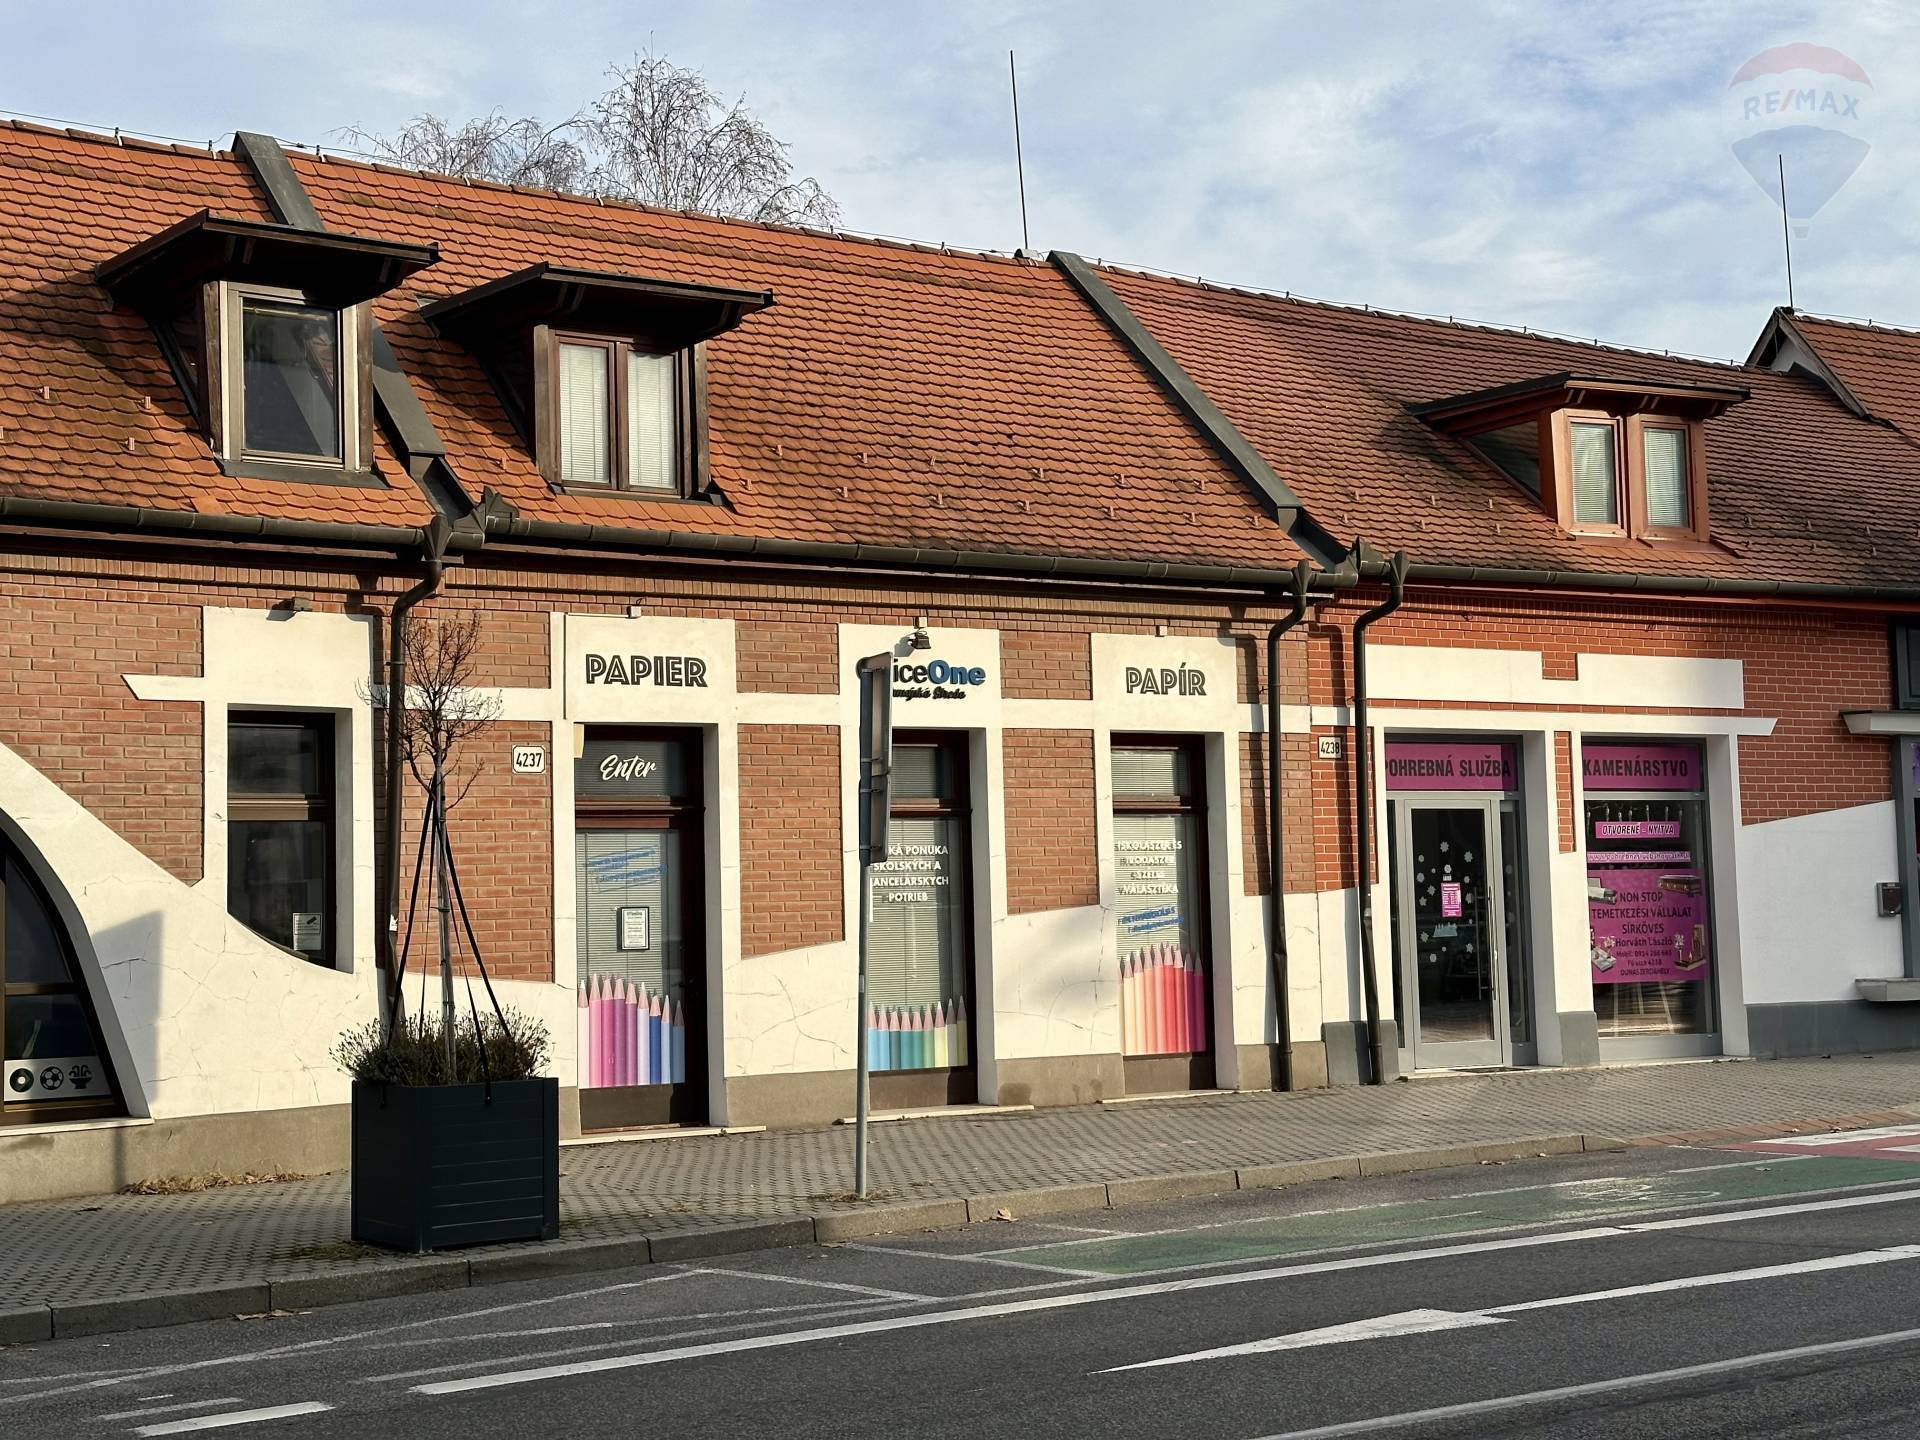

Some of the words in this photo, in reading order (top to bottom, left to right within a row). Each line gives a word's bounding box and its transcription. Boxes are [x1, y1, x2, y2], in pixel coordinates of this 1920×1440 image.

[585, 653, 708, 688] PAPIER
[892, 658, 987, 686] iceOne
[1125, 661, 1207, 696] PAPÍR
[1320, 740, 1340, 755] 4238
[515, 751, 543, 768] 4237
[600, 754, 657, 782] Enter
[1459, 754, 1511, 777] SLUŽBA
[1583, 754, 1689, 777] KAMENÁRSTVO
[888, 842, 903, 856] KÁ
[905, 845, 949, 857] PONUKA
[934, 860, 942, 870] A
[888, 891, 929, 903] POTRIEB
[1619, 892, 1639, 903] NON
[1641, 891, 1663, 902] STOP
[1591, 907, 1649, 920] TEMETKEZÉSI
[1650, 905, 1693, 919] VÁLLALAT
